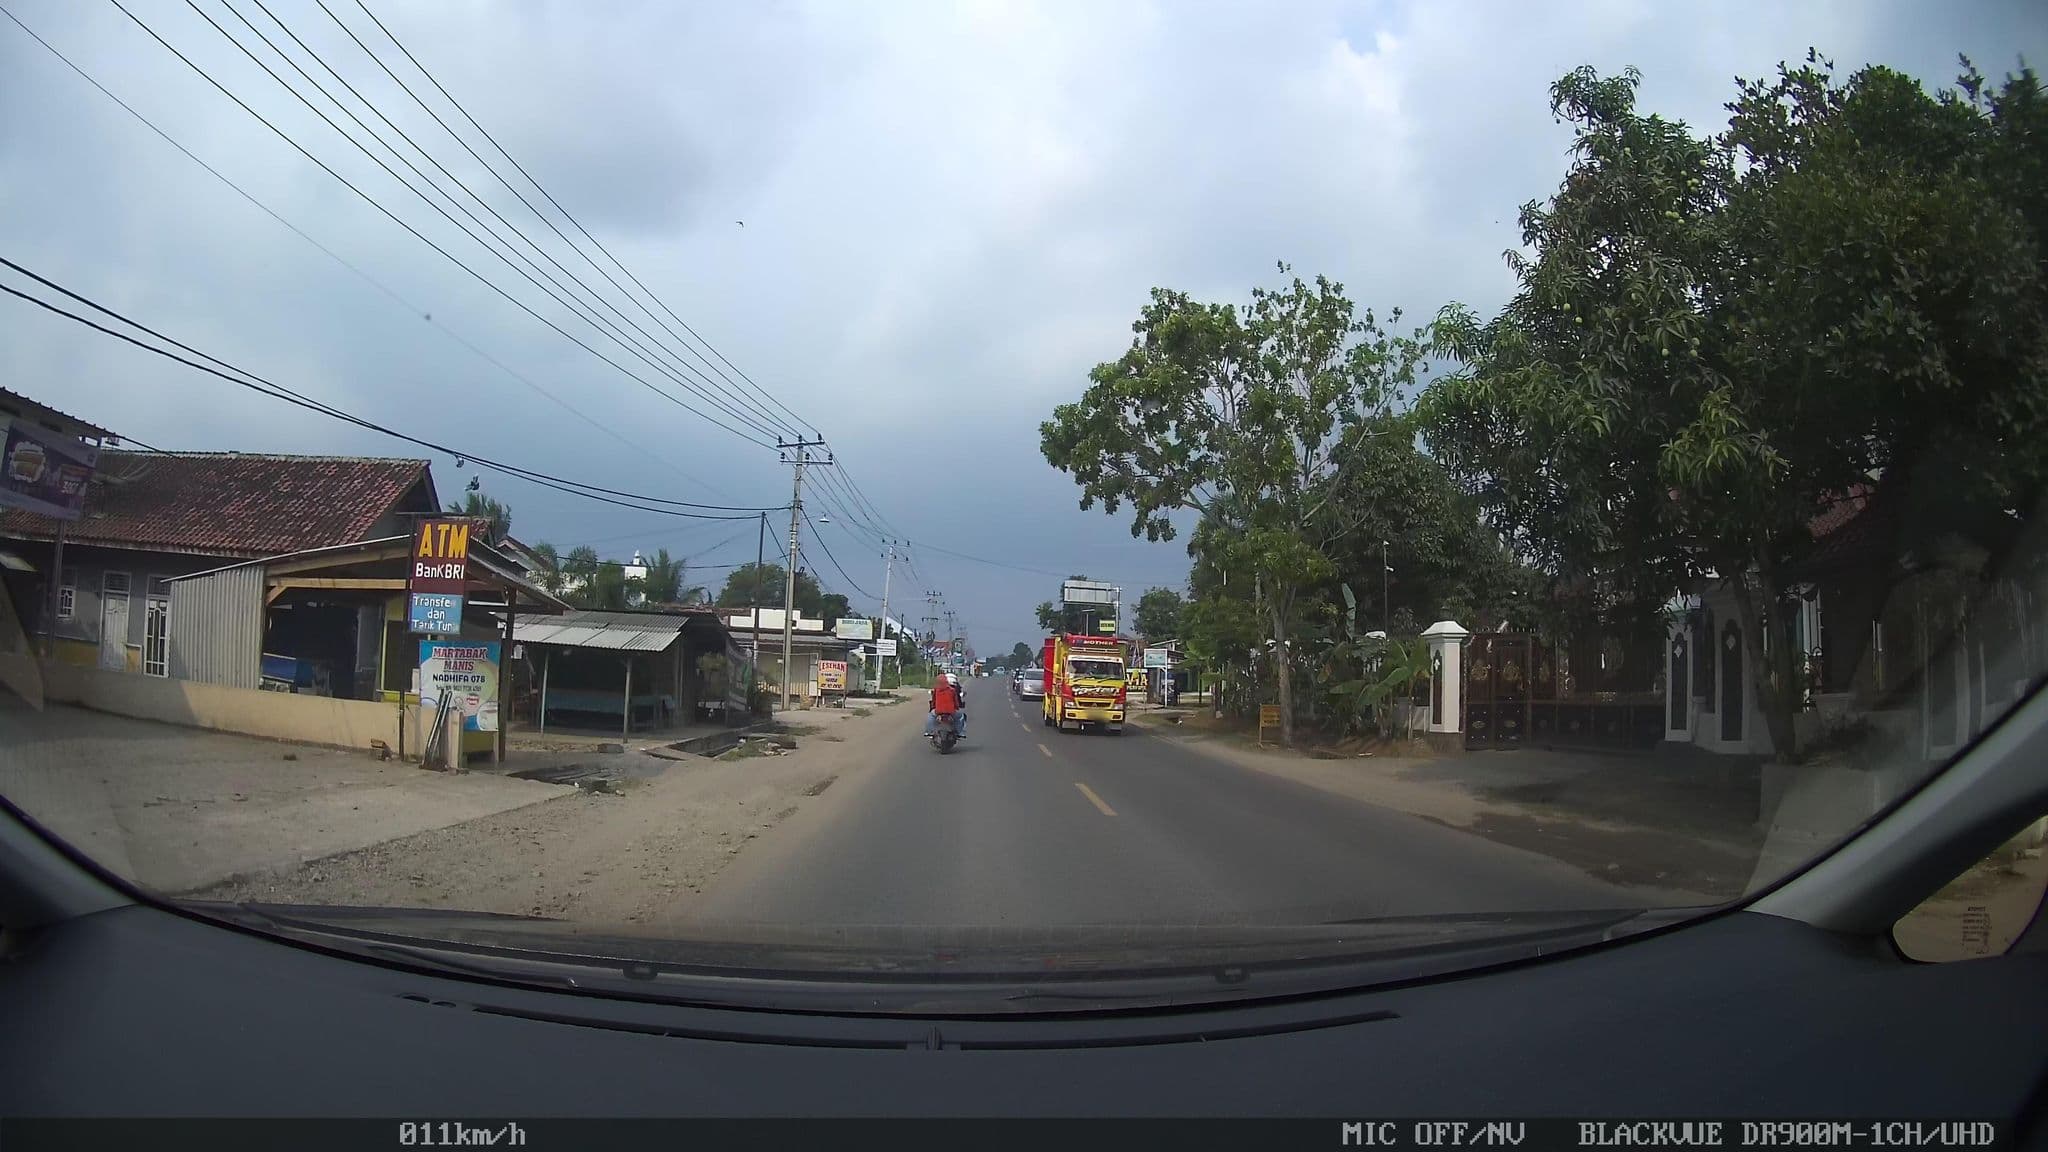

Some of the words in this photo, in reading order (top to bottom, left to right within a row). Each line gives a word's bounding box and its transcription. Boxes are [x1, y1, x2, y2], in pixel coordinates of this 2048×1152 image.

[418, 523, 468, 558] ATM
[427, 608, 445, 620] dan
[432, 647, 488, 660] MARTABAK
[443, 660, 474, 673] MANIS
[433, 674, 469, 683] NADHIFA
